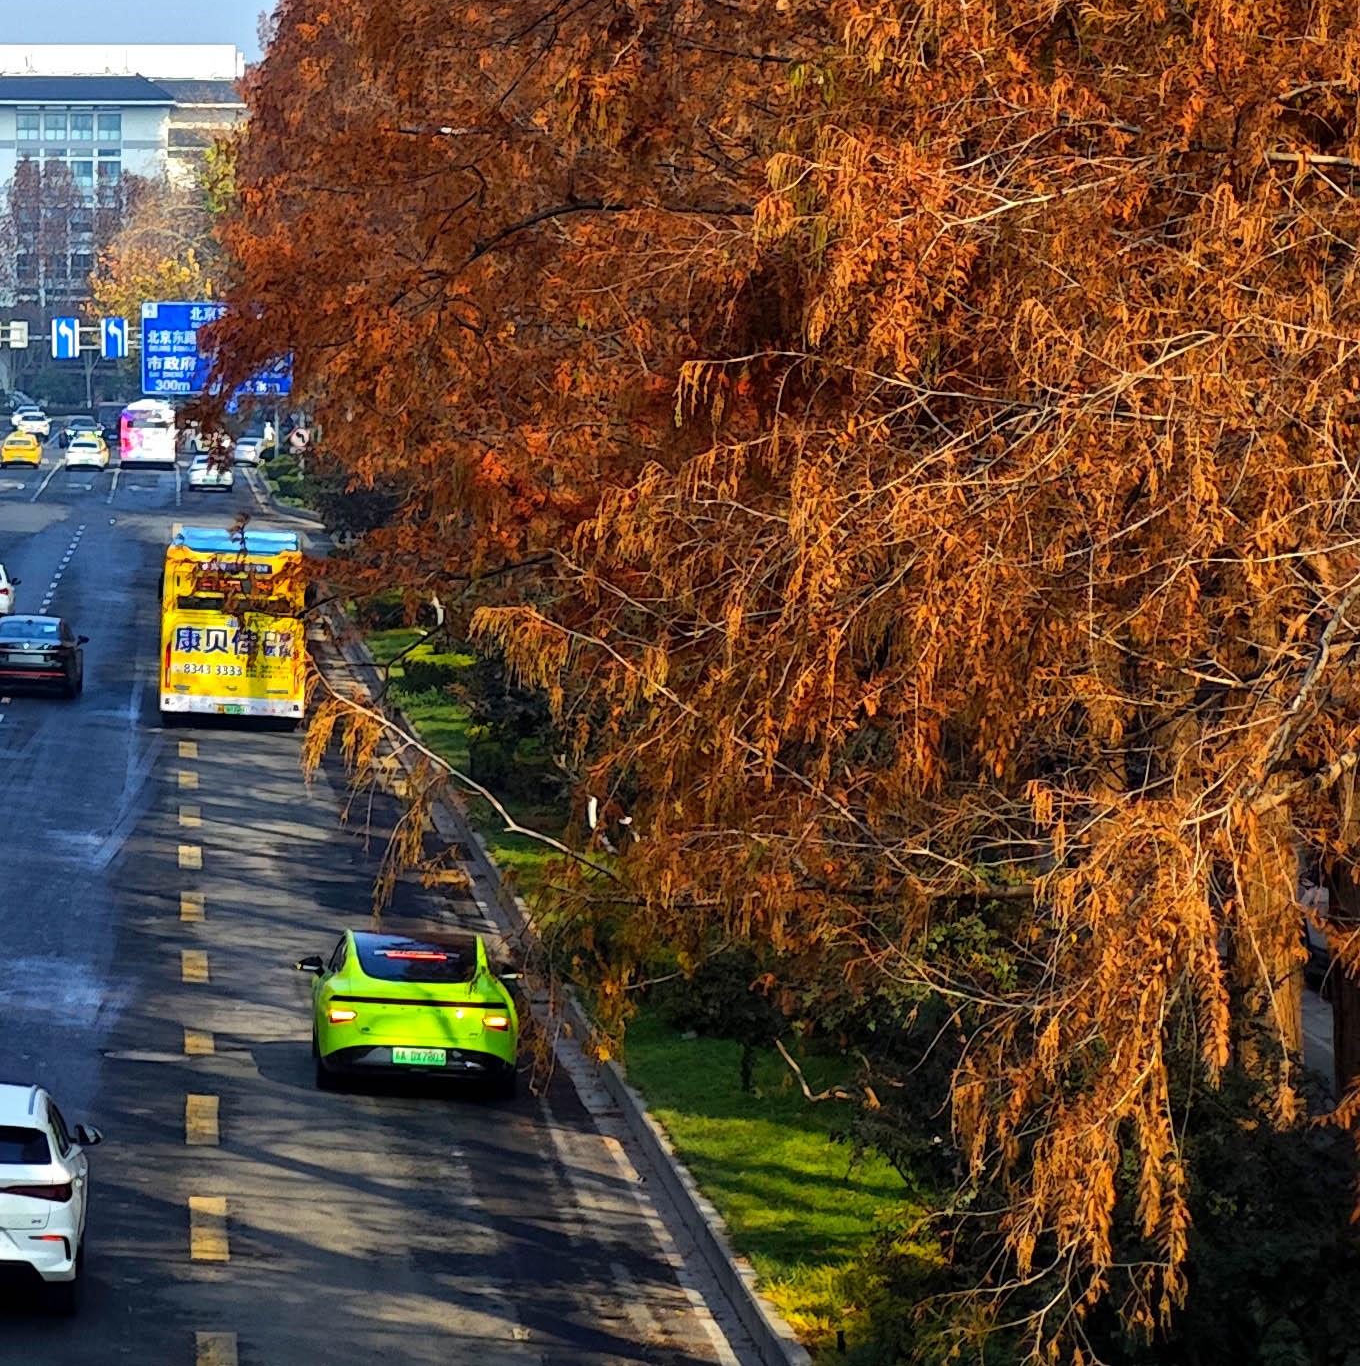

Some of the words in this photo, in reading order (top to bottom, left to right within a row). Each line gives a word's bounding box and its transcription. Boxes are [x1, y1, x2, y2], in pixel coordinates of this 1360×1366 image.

[146, 356, 197, 372] 市政府
[155, 379, 191, 391] 300m
